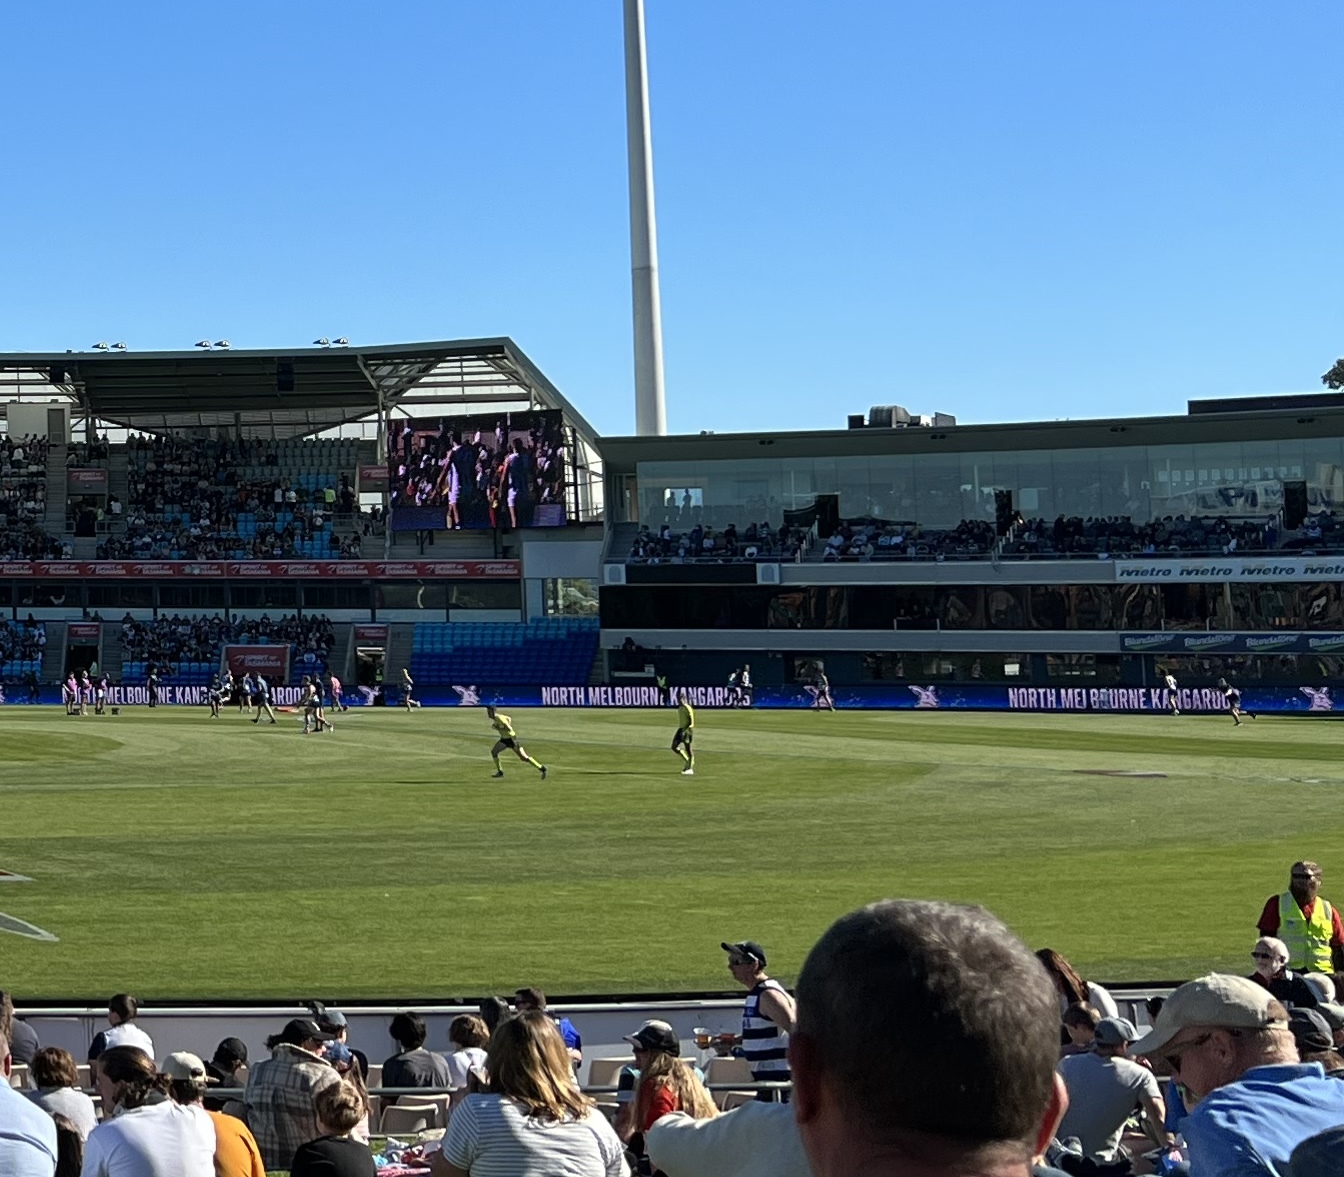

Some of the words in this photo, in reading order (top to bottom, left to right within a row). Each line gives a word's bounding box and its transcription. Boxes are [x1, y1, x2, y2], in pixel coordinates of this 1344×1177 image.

[106, 686, 173, 704] MELBOUNE
[542, 686, 585, 705] NORTH
[1008, 687, 1057, 709] NORTH
